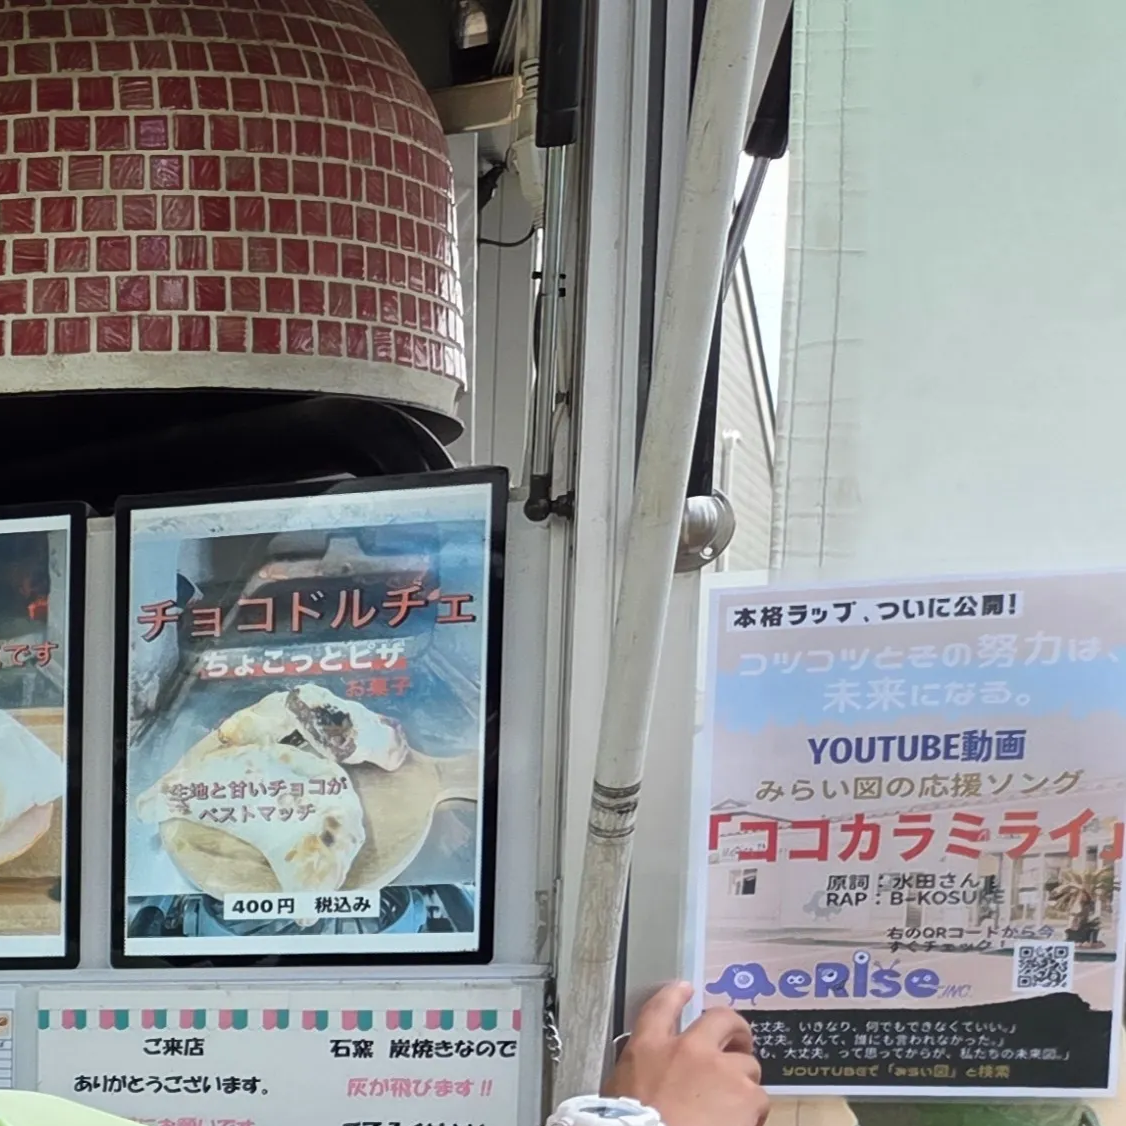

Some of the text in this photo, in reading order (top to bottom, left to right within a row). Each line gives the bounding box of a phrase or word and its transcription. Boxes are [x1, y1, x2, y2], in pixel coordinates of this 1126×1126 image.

[137, 584, 476, 642] チョコドルチェ
[203, 641, 406, 678] ちょこっとピザ
[822, 676, 1032, 714] 未来になる。
[808, 729, 1027, 765] YOUTUBE動画
[756, 769, 1084, 804] みらい図の応援ソング
[199, 804, 316, 824] ベストマッチ
[708, 808, 1125, 863] 「ココカラミライ」
[232, 896, 372, 915] 400円 税込み
[143, 1037, 205, 1057] ご来店
[330, 1039, 517, 1059] 石窯 炭焼きなので
[74, 1074, 270, 1097] ありがとうございます。
